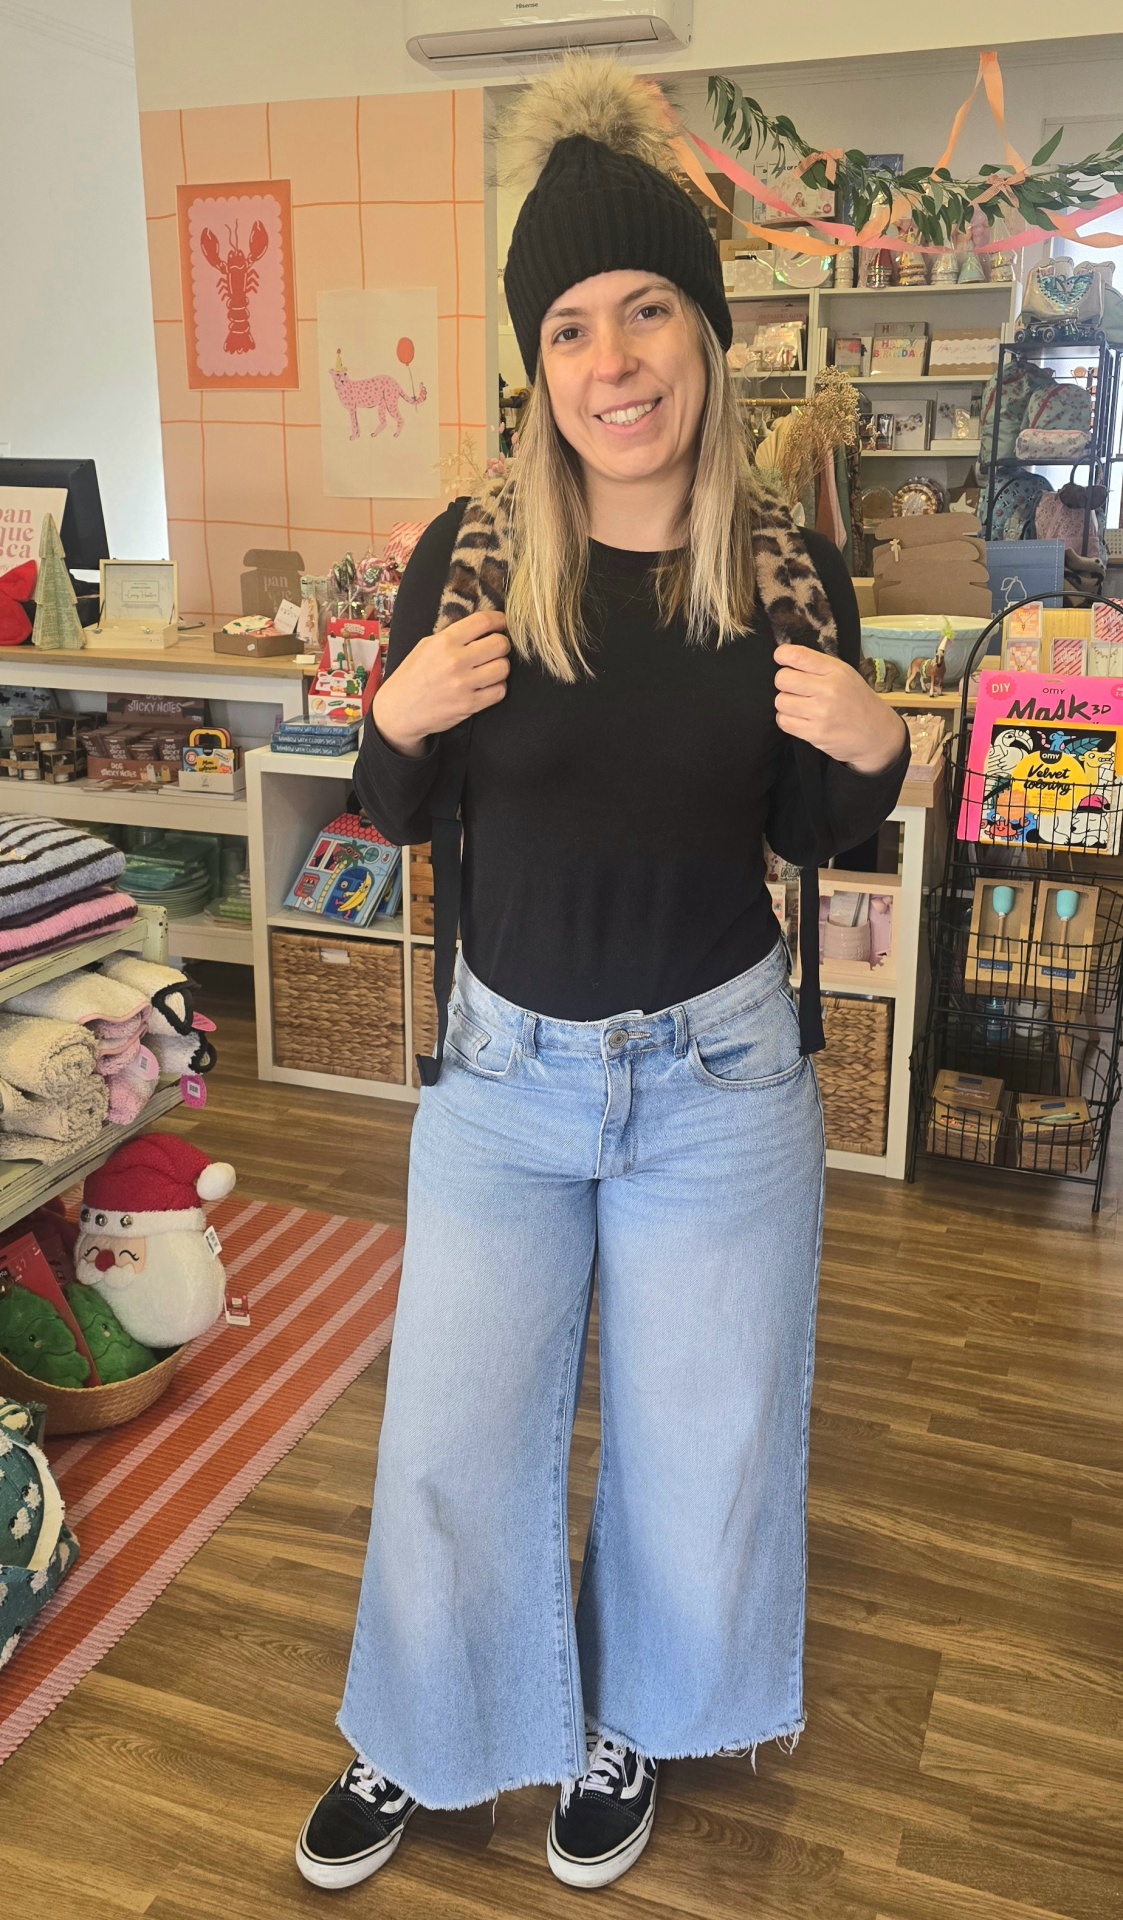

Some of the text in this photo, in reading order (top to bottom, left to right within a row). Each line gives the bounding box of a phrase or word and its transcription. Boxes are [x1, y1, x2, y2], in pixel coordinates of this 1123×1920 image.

[263, 576, 288, 592] pan
[991, 683, 1011, 693] DIY
[128, 700, 182, 713] STICKY NOTES
[1006, 694, 1112, 721] Mask 3D
[101, 768, 137, 778] STICKY NOTES
[1027, 764, 1071, 779] Velvet
[1023, 779, 1072, 796] coloring
